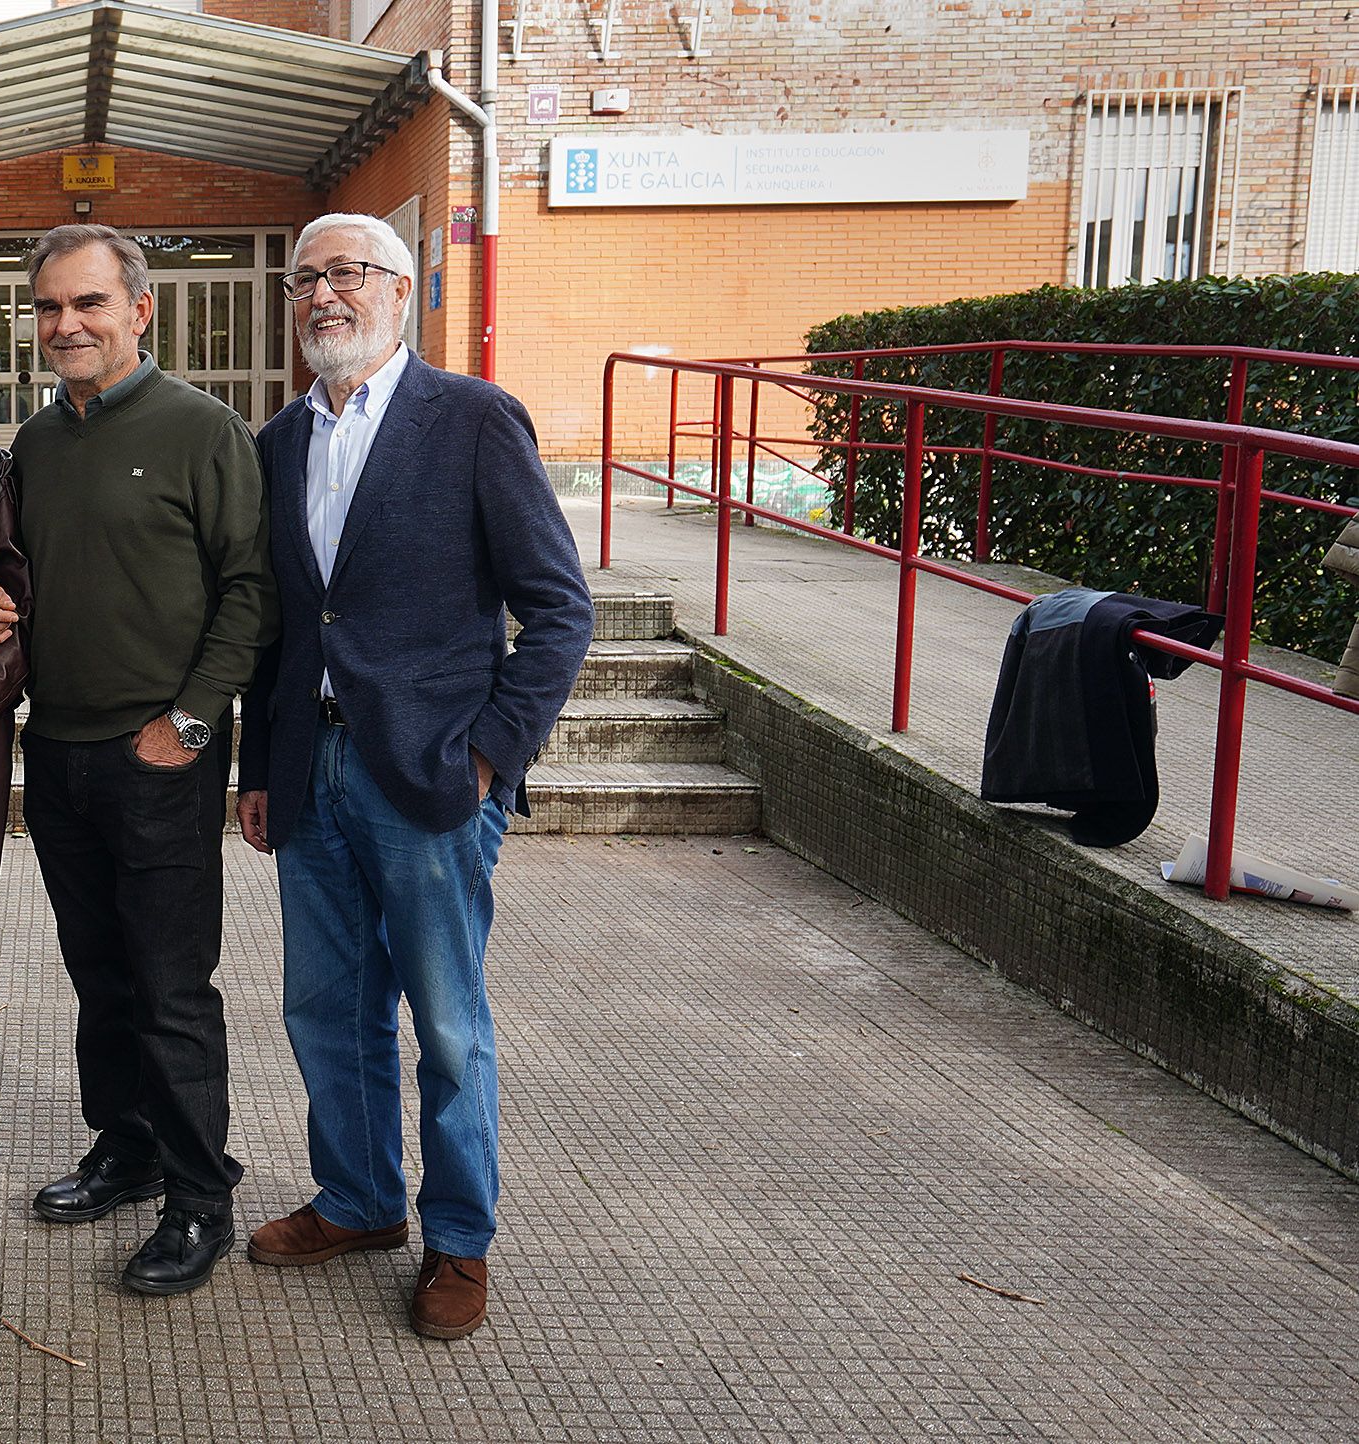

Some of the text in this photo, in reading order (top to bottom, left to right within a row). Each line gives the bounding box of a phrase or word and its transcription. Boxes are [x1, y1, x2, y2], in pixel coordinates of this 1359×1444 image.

[746, 147, 811, 158] INSTITUTO
[608, 151, 680, 168] XUNTA
[745, 163, 820, 175] SECUNDARIA
[606, 171, 725, 190] DE GALICIA
[745, 181, 753, 191] A
[757, 179, 826, 192] XUNQUEIRA
